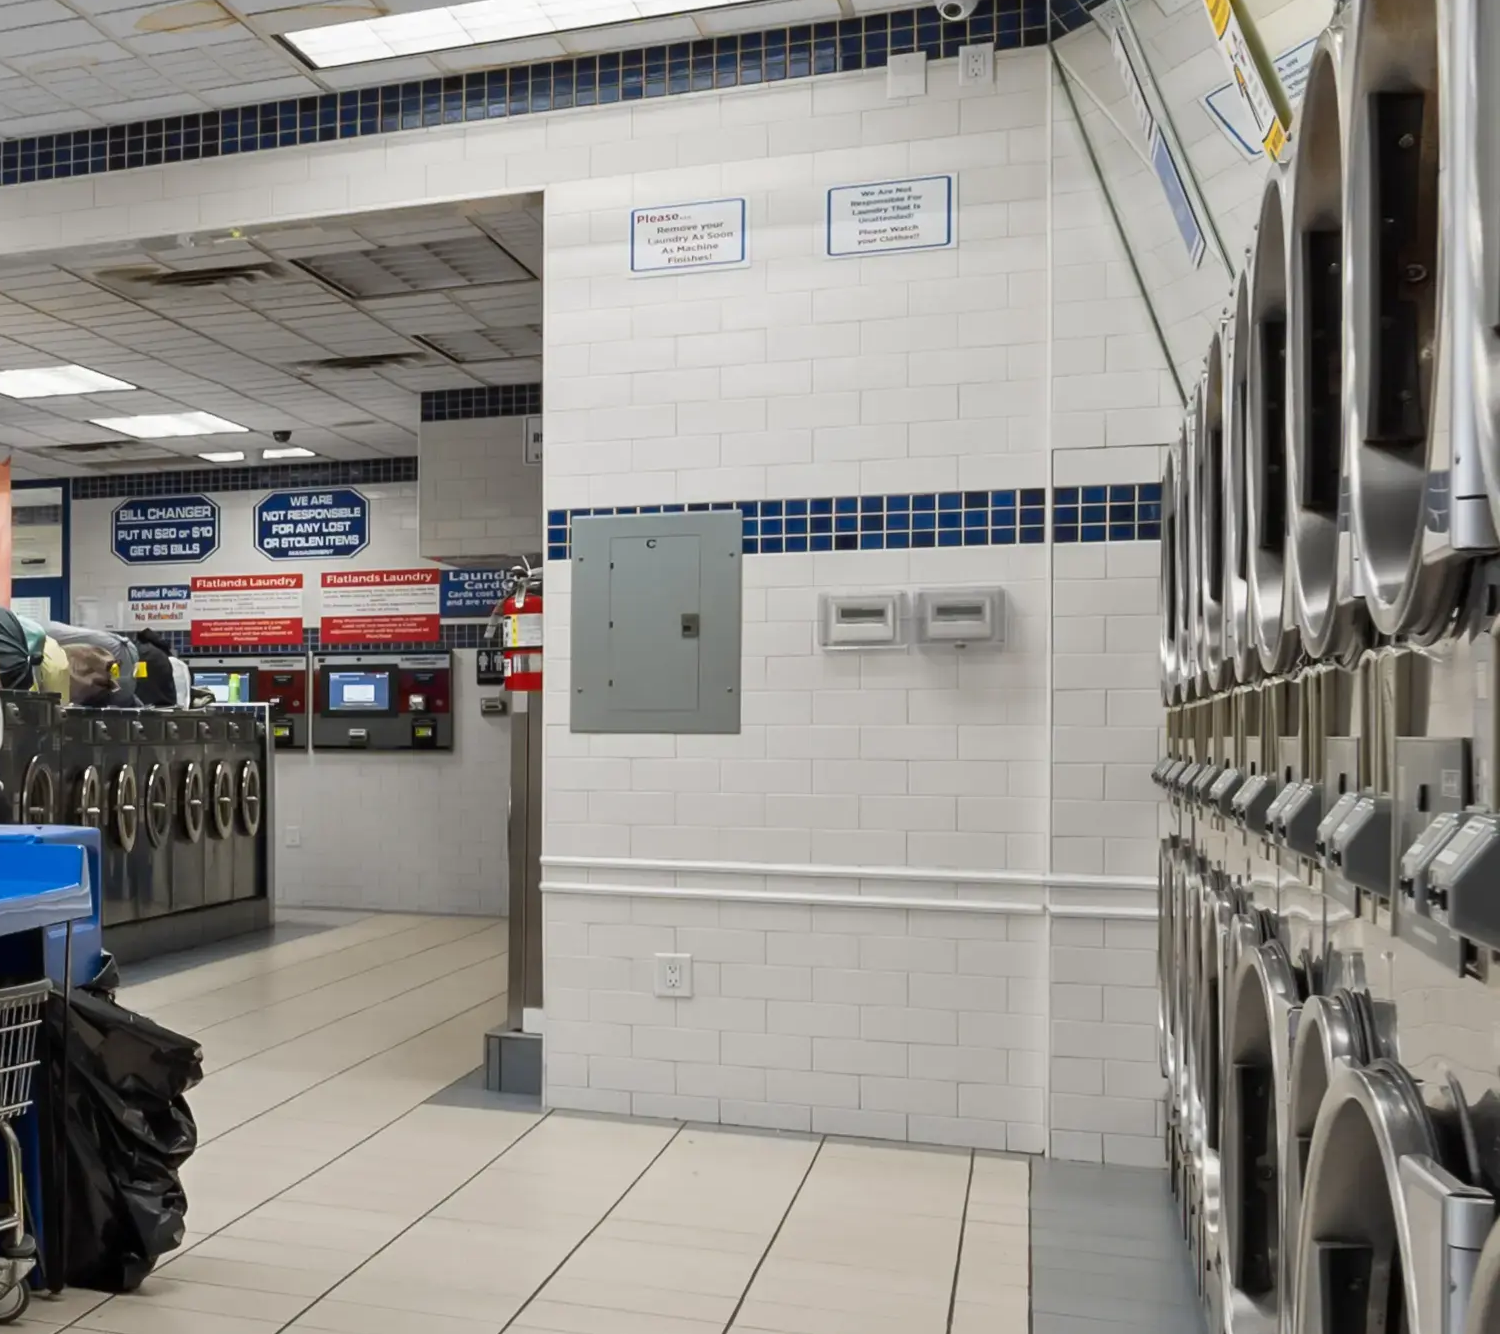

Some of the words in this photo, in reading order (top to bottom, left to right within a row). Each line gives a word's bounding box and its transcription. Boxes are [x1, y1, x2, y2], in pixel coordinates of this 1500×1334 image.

[850, 197, 905, 207] Responsible
[852, 207, 888, 216] Laundry
[891, 204, 910, 212] That
[657, 224, 698, 234] Remove
[700, 222, 724, 231] your
[859, 228, 887, 236] Please
[890, 225, 919, 233] Watch
[648, 235, 689, 246] Laundry
[707, 231, 734, 240] Soon
[661, 247, 674, 255] As
[677, 243, 719, 253] Machine
[289, 496, 308, 507] WE
[309, 495, 333, 506] ARE
[119, 509, 145, 521] BILL
[147, 506, 212, 520] CHANGER
[262, 510, 286, 521] NOT
[287, 507, 361, 520] RESPONSIBLE
[118, 528, 139, 541] PUT
[141, 529, 153, 540] IN
[154, 527, 176, 539] $20
[178, 529, 190, 539] or
[191, 526, 213, 538] $10
[271, 523, 294, 535] FOR
[296, 522, 320, 533] ANY
[322, 521, 351, 533] LOST
[263, 537, 280, 549] OR
[281, 535, 324, 547] STOLEN
[325, 534, 360, 546] ITEMS
[646, 539, 657, 549] C
[129, 545, 151, 557] GET
[170, 543, 200, 556] BILLS
[326, 574, 380, 585] Flatlands
[382, 572, 433, 584] Laundry
[448, 569, 514, 582] Laundr
[196, 578, 247, 589] Flatlands
[249, 576, 297, 588] Laundry
[130, 588, 160, 599] Refund
[162, 586, 188, 600] Policy
[448, 590, 473, 598] Cards
[475, 590, 495, 598] cost
[131, 602, 140, 611] All
[141, 602, 158, 611] Sales
[159, 602, 170, 611] Are
[171, 601, 188, 610] Final
[135, 613, 146, 622] No
